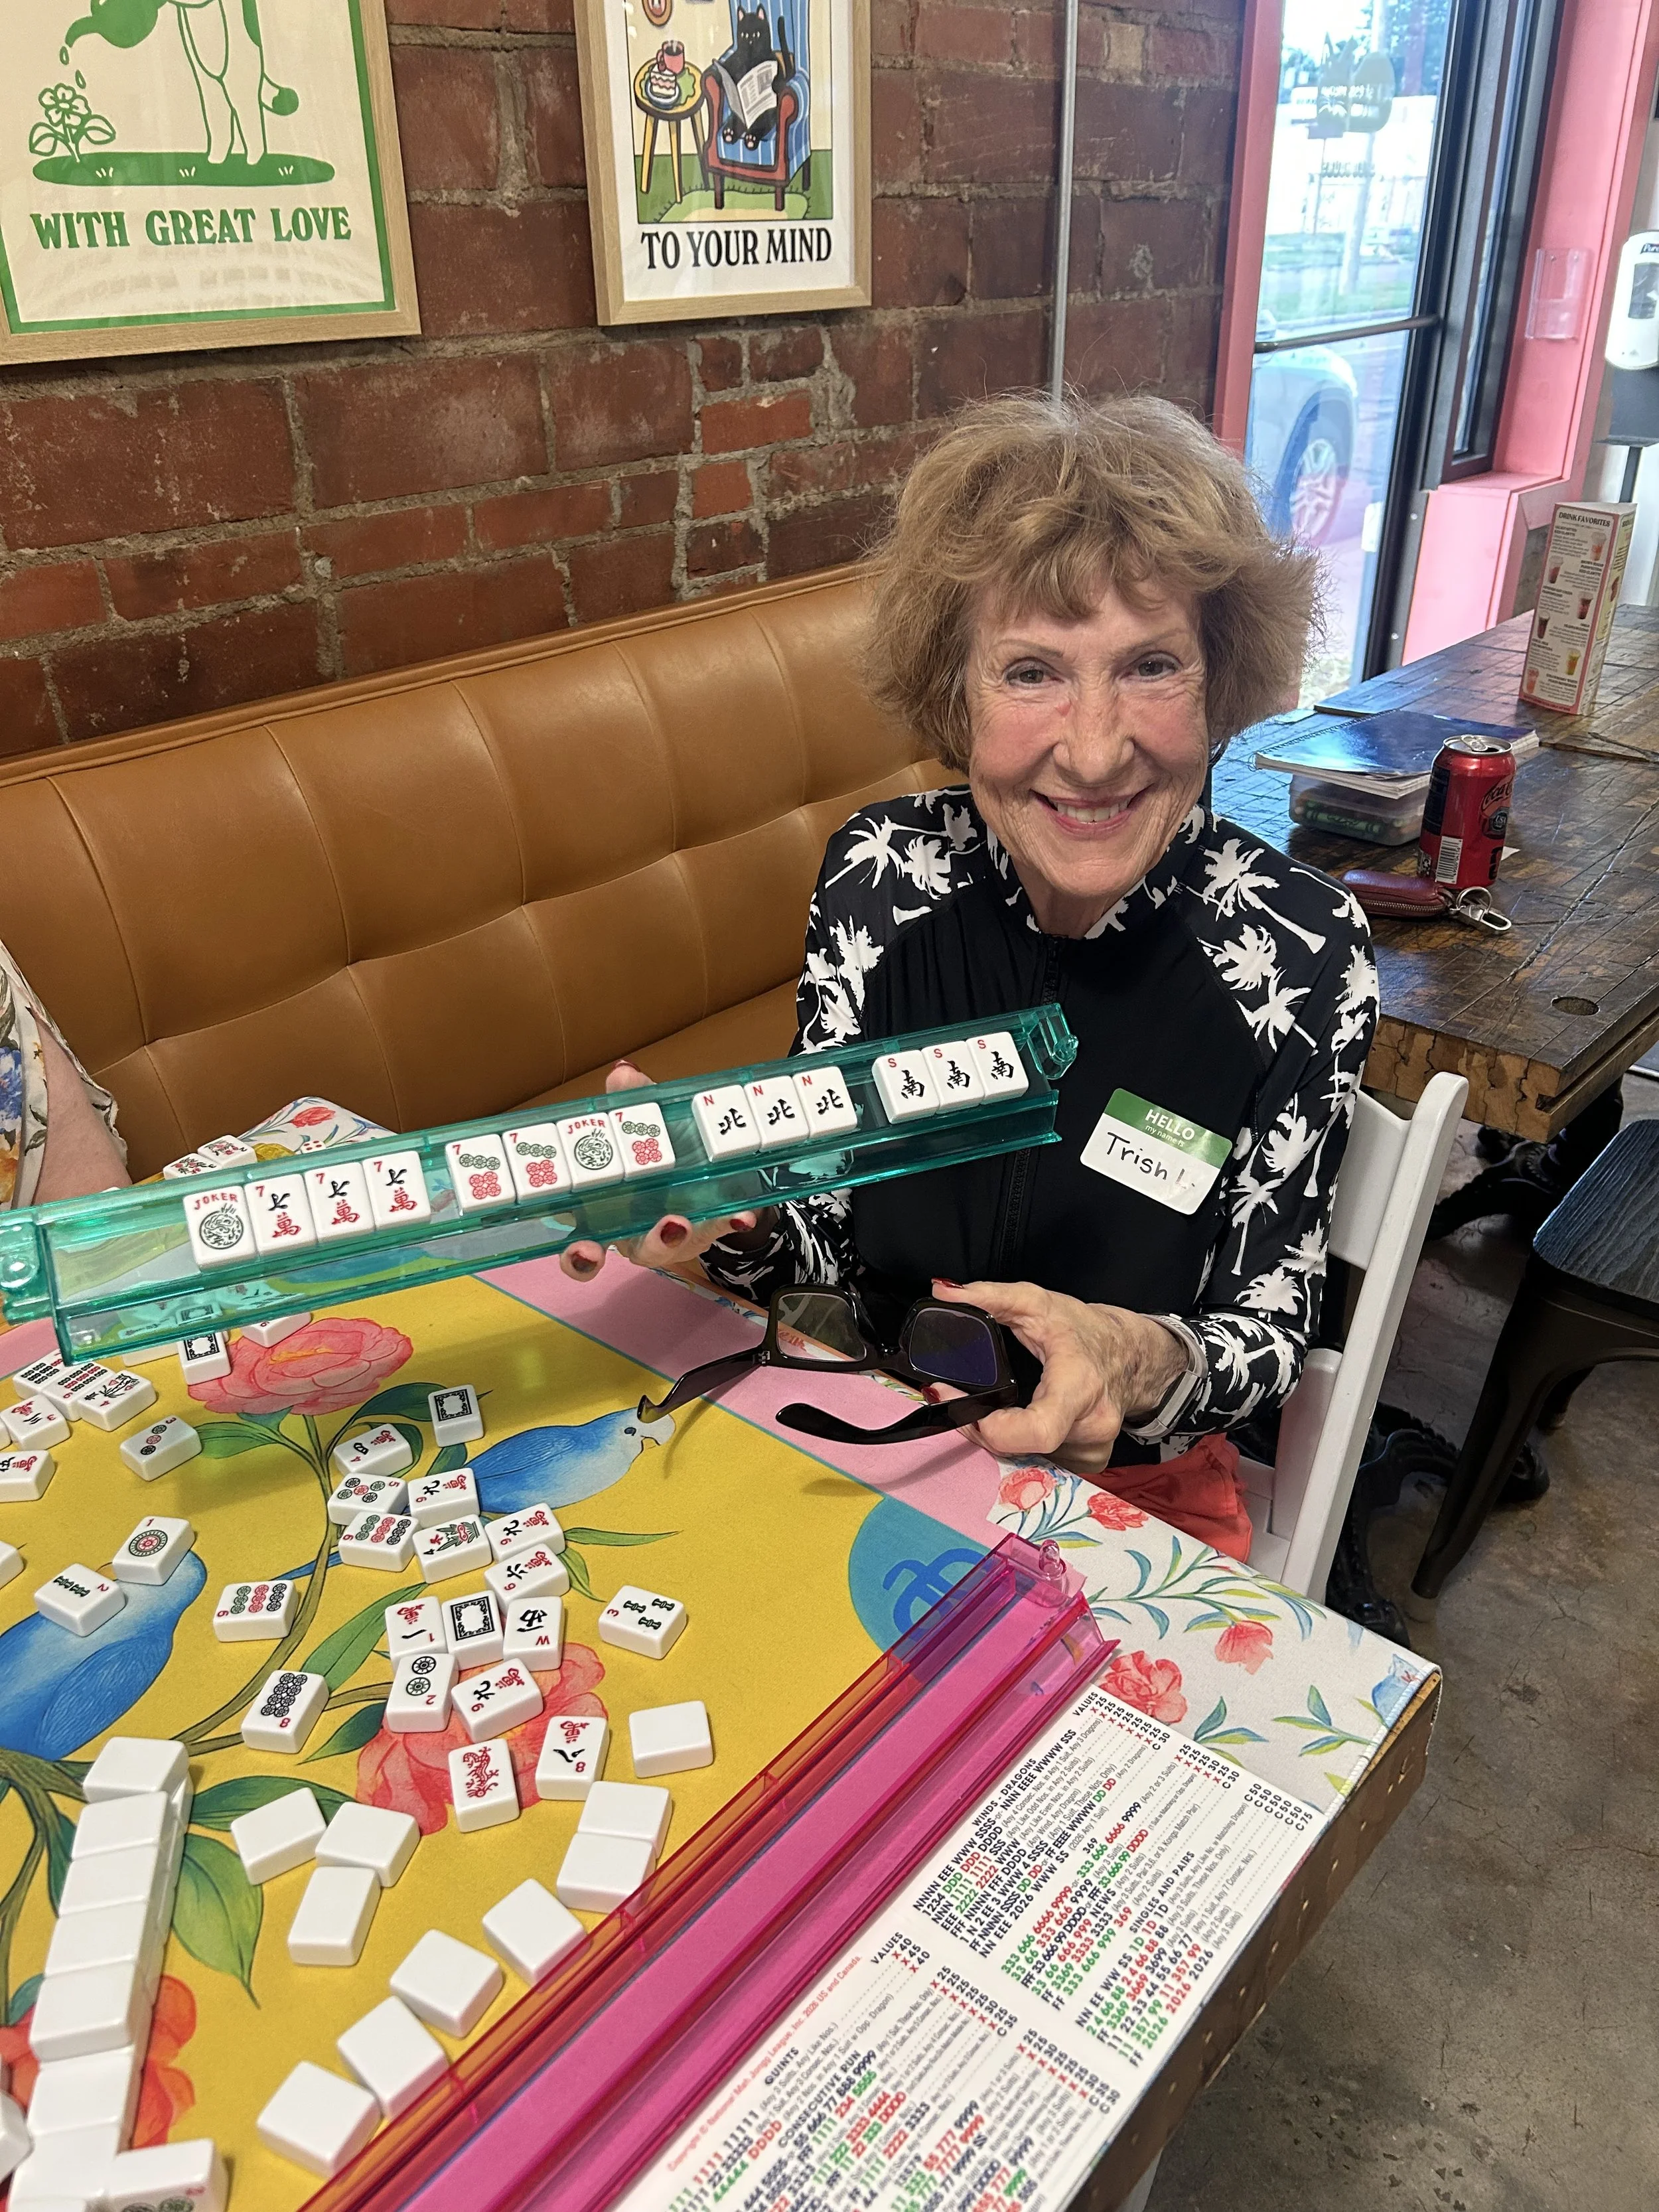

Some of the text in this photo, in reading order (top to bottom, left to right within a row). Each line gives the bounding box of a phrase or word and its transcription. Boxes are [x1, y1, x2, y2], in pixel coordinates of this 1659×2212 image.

[31, 206, 352, 250] WITH GREAT LOVE
[641, 227, 832, 269] TO YOUR MIND
[1559, 512, 1577, 522] DRINK
[1577, 516, 1611, 528] FAVORITES
[934, 1049, 942, 1058] S
[977, 1040, 986, 1049] S
[888, 1059, 897, 1067] S
[947, 1061, 970, 1089] 南
[991, 1051, 1014, 1079] 南
[753, 1086, 763, 1096] N
[802, 1076, 812, 1086] N
[901, 1070, 924, 1099] 南
[703, 1095, 714, 1106] N
[767, 1099, 795, 1125] 北
[816, 1089, 843, 1115] 北
[568, 1119, 605, 1136] JOKER
[615, 1112, 622, 1122] 7
[719, 1108, 746, 1135] 北
[1145, 1110, 1195, 1140] HELLO
[510, 1133, 518, 1143] 7
[1145, 1124, 1157, 1136] my
[1157, 1128, 1177, 1144] name
[453, 1144, 461, 1155] 7
[1107, 1132, 1167, 1180] Trish
[316, 1173, 325, 1184] 7
[374, 1161, 382, 1172] 7
[194, 1191, 238, 1211] JOKER
[255, 1186, 265, 1197] 7
[429, 1633, 435, 1642] 1
[426, 1695, 436, 1705] 2
[1072, 1692, 1098, 1716] VALUES
[279, 1718, 291, 1728] 8
[999, 1789, 1021, 1810] NNN
[1017, 1772, 1037, 1791] EEEE
[1033, 1742, 1062, 1773] WWWW
[1060, 1729, 1076, 1743] SSS
[1095, 1696, 1107, 1707] 25
[575, 1762, 585, 1773] 8
[972, 1800, 998, 1826] WINDS
[1000, 1758, 1036, 1795] DRAGONS
[922, 1892, 945, 1916] 1234
[942, 1872, 962, 1893] DDD
[960, 1852, 980, 1872] DDD
[977, 1826, 1002, 1852] DDDD
[1104, 1701, 1116, 1712] 25
[931, 1900, 954, 1924] NNN
[950, 1878, 972, 1900] 1111
[970, 1855, 991, 1877] 1111
[989, 1838, 1006, 1856] SSS
[1113, 1706, 1124, 1717] 25
[950, 1919, 966, 1937] FFF
[963, 1890, 991, 1921] NNNN
[987, 1874, 1003, 1891] FFF
[1001, 1848, 1027, 1876] DDDD
[1131, 1716, 1143, 1728] 25
[978, 1939, 996, 1958] NN
[993, 1919, 1012, 1939] EEE
[1009, 1893, 1033, 1920] 2026
[1030, 1862, 1057, 1891] WWW
[1055, 1850, 1068, 1863] SS
[1158, 1732, 1170, 1743] 30
[1082, 1837, 1098, 1854] 369
[912, 1837, 977, 1911] NNNN EEE WWW
[1129, 1851, 1194, 1933] SINGLES AND PAIRS
[870, 1932, 902, 1964] VALUES
[899, 1938, 912, 1951] 40
[1129, 2050, 1143, 2067] FF
[1141, 2016, 1168, 2049] 2026
[1165, 1982, 1190, 2014] 2026
[1189, 1949, 1213, 1980] 2026
[1299, 1812, 1312, 1824] 75
[764, 2047, 798, 2085] QUINTS
[778, 2049, 861, 2148] CONSECUTIVE RUN
